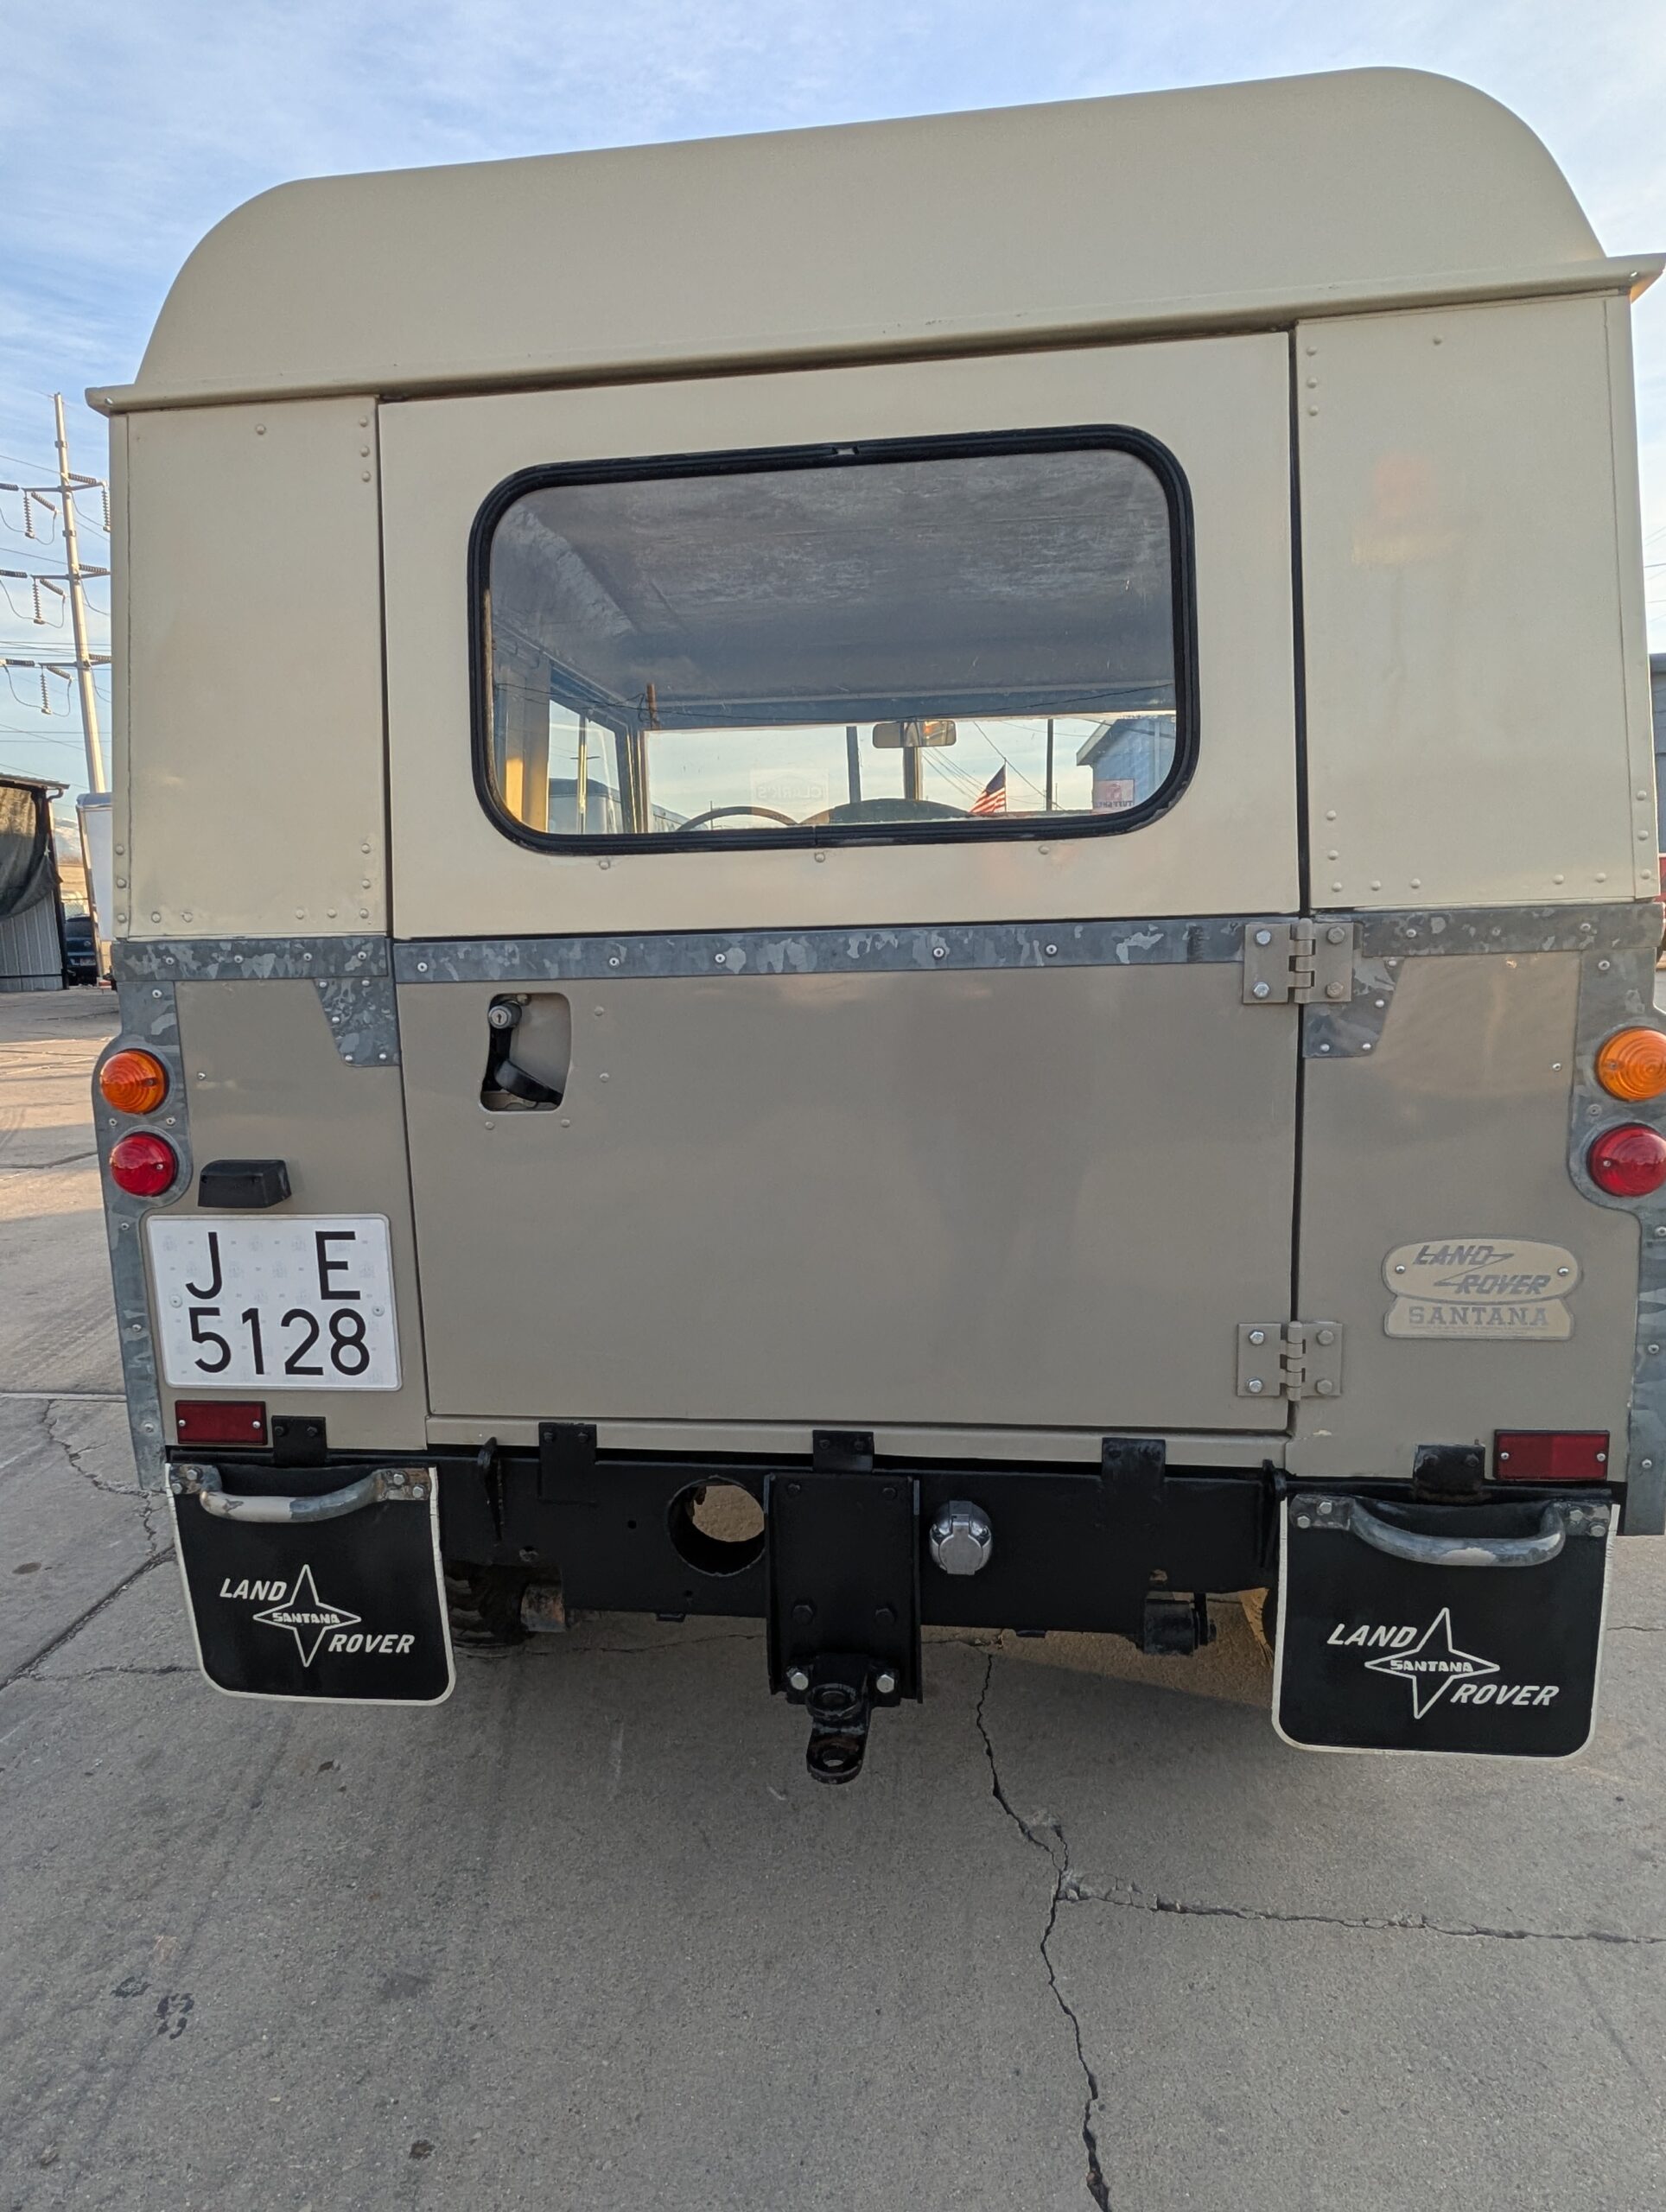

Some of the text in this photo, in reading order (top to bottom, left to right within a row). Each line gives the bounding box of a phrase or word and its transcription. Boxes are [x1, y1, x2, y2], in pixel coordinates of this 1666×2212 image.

[185, 1230, 361, 1300] J E
[1413, 1244, 1495, 1266] LAND
[1454, 1274, 1552, 1295] ROVER
[1408, 1306, 1549, 1326] SANTANA
[188, 1306, 371, 1376] 5128
[219, 1578, 288, 1601] LAND
[271, 1612, 341, 1624] SANTANA
[327, 1633, 416, 1655] ROVER
[1326, 1623, 1418, 1649] LAND
[1389, 1659, 1474, 1673] SANTANA
[1449, 1683, 1561, 1707] ROVER
